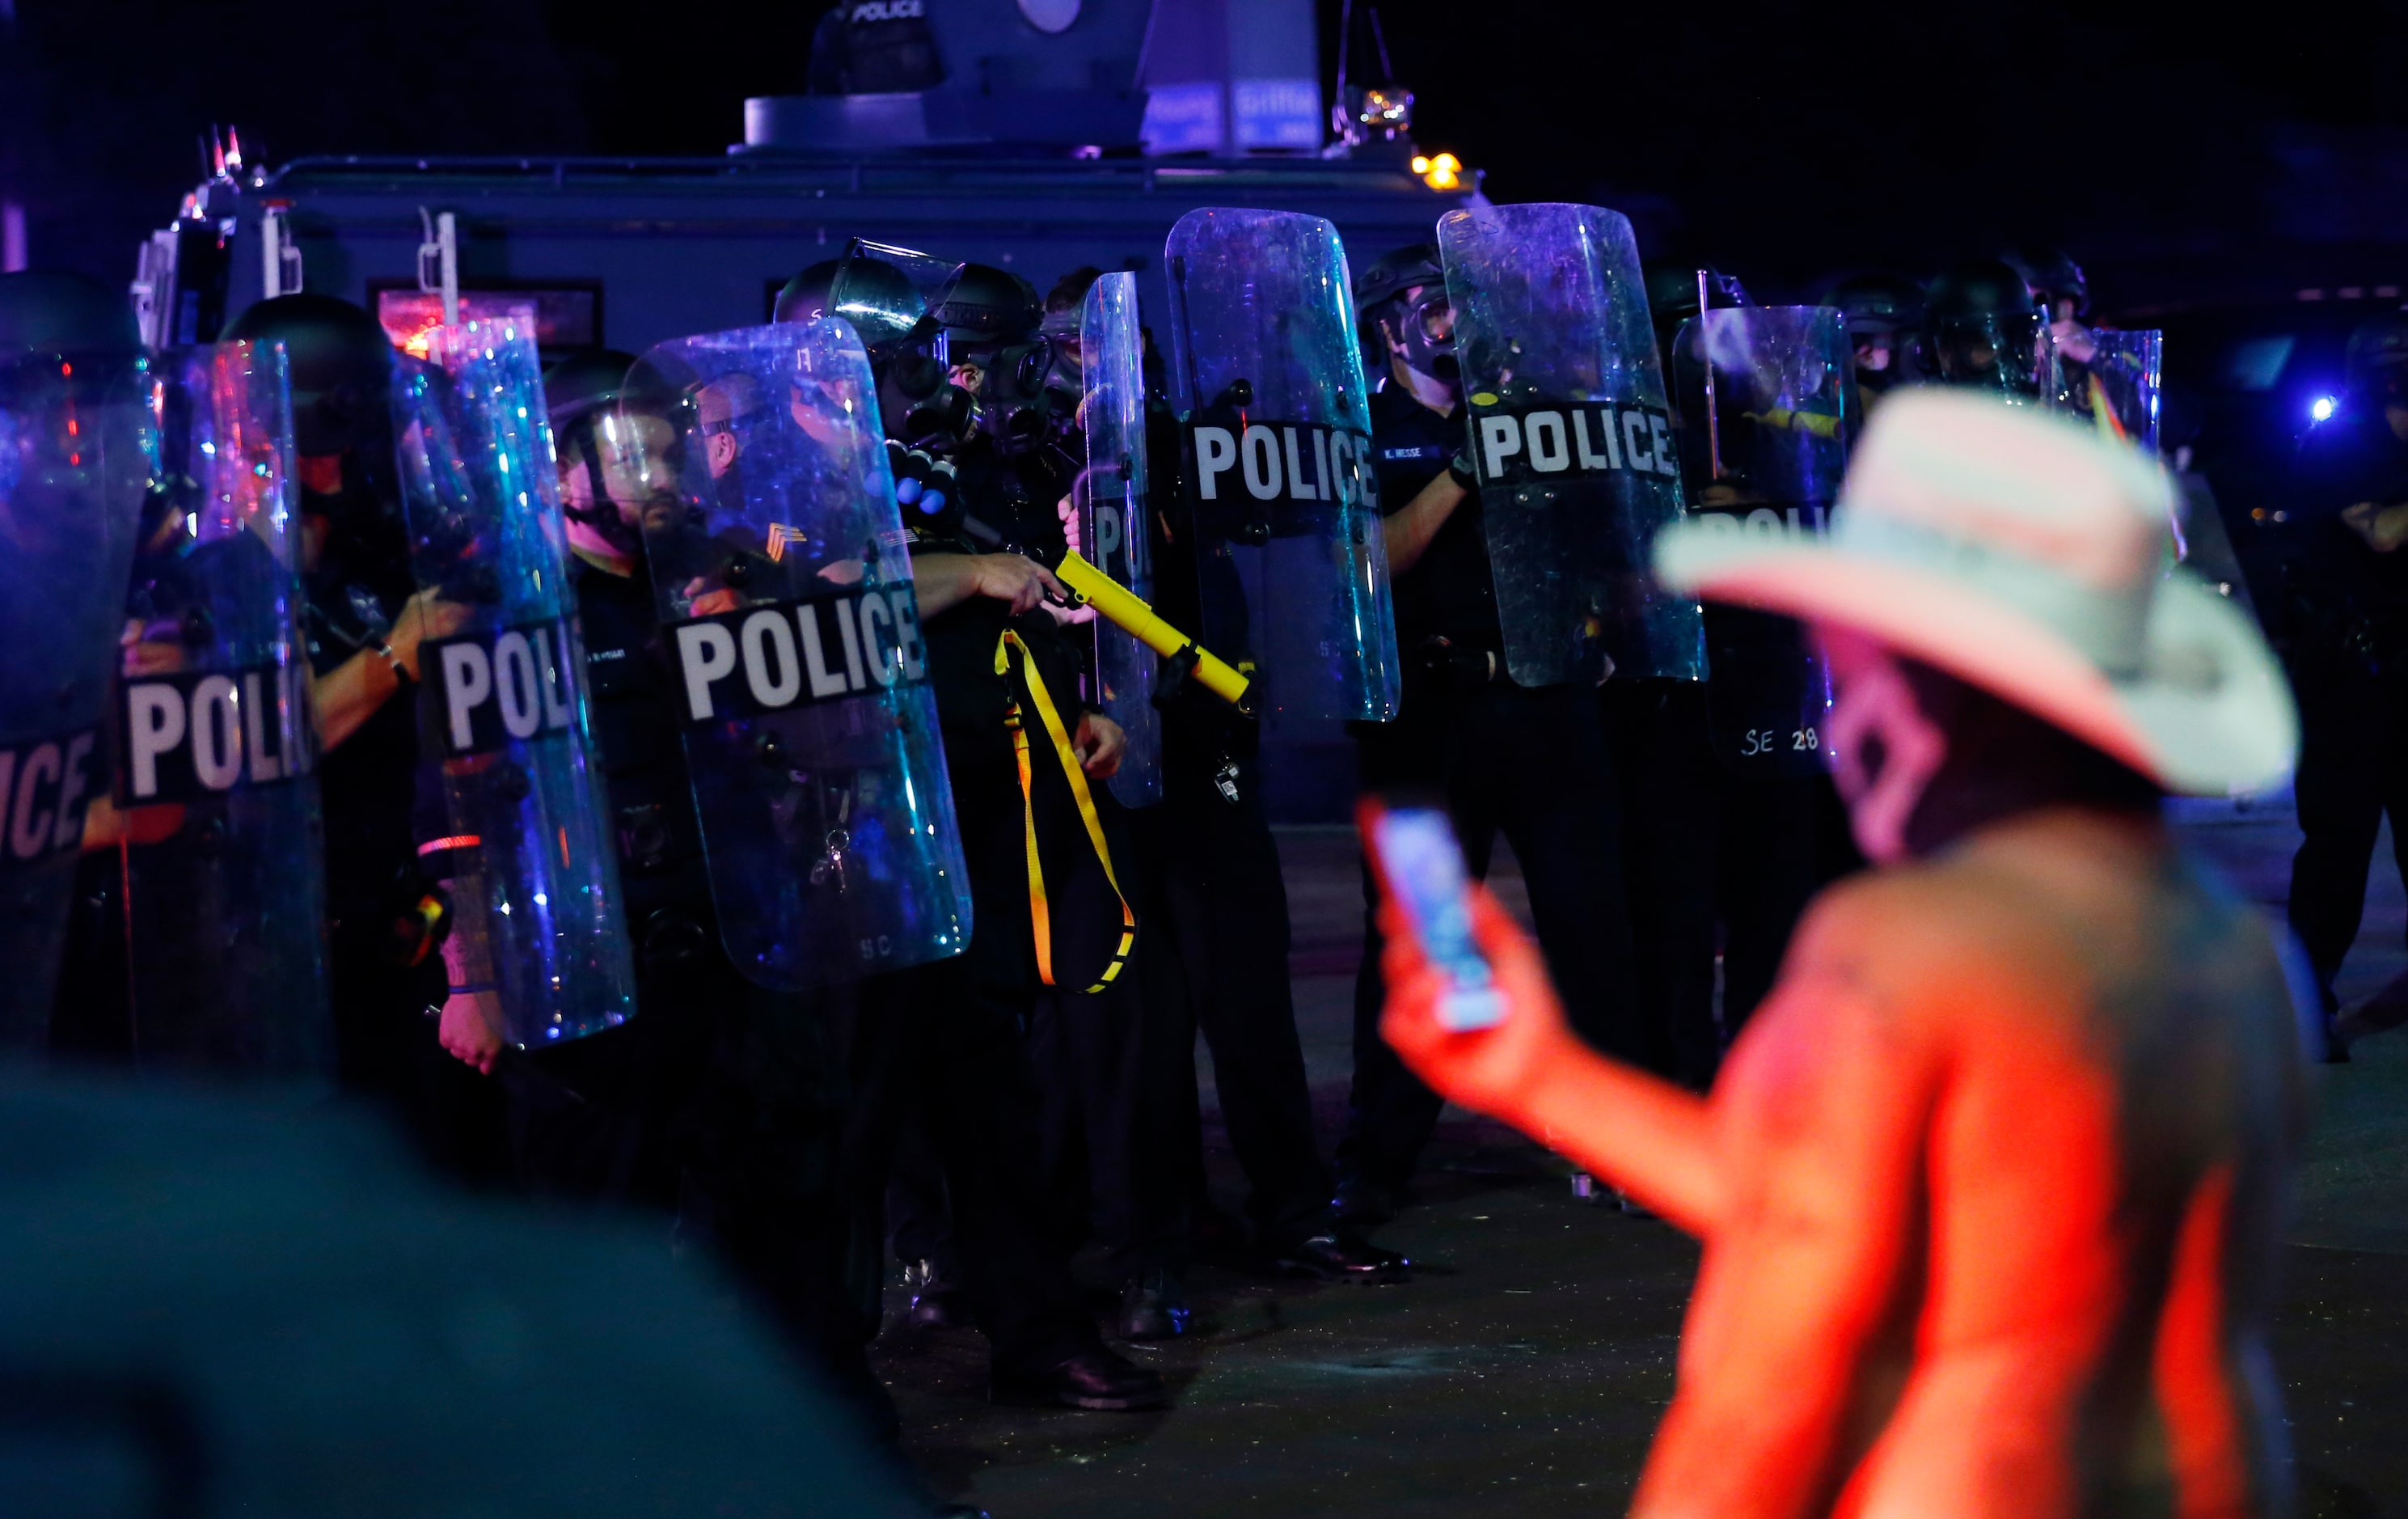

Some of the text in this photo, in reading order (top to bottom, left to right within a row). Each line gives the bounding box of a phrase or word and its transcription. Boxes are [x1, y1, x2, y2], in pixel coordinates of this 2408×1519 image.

[1193, 425, 1378, 508] POLICE
[1479, 408, 1676, 479] POLICE
[676, 590, 925, 721] POLICE
[1739, 726, 1819, 756] SE 28
